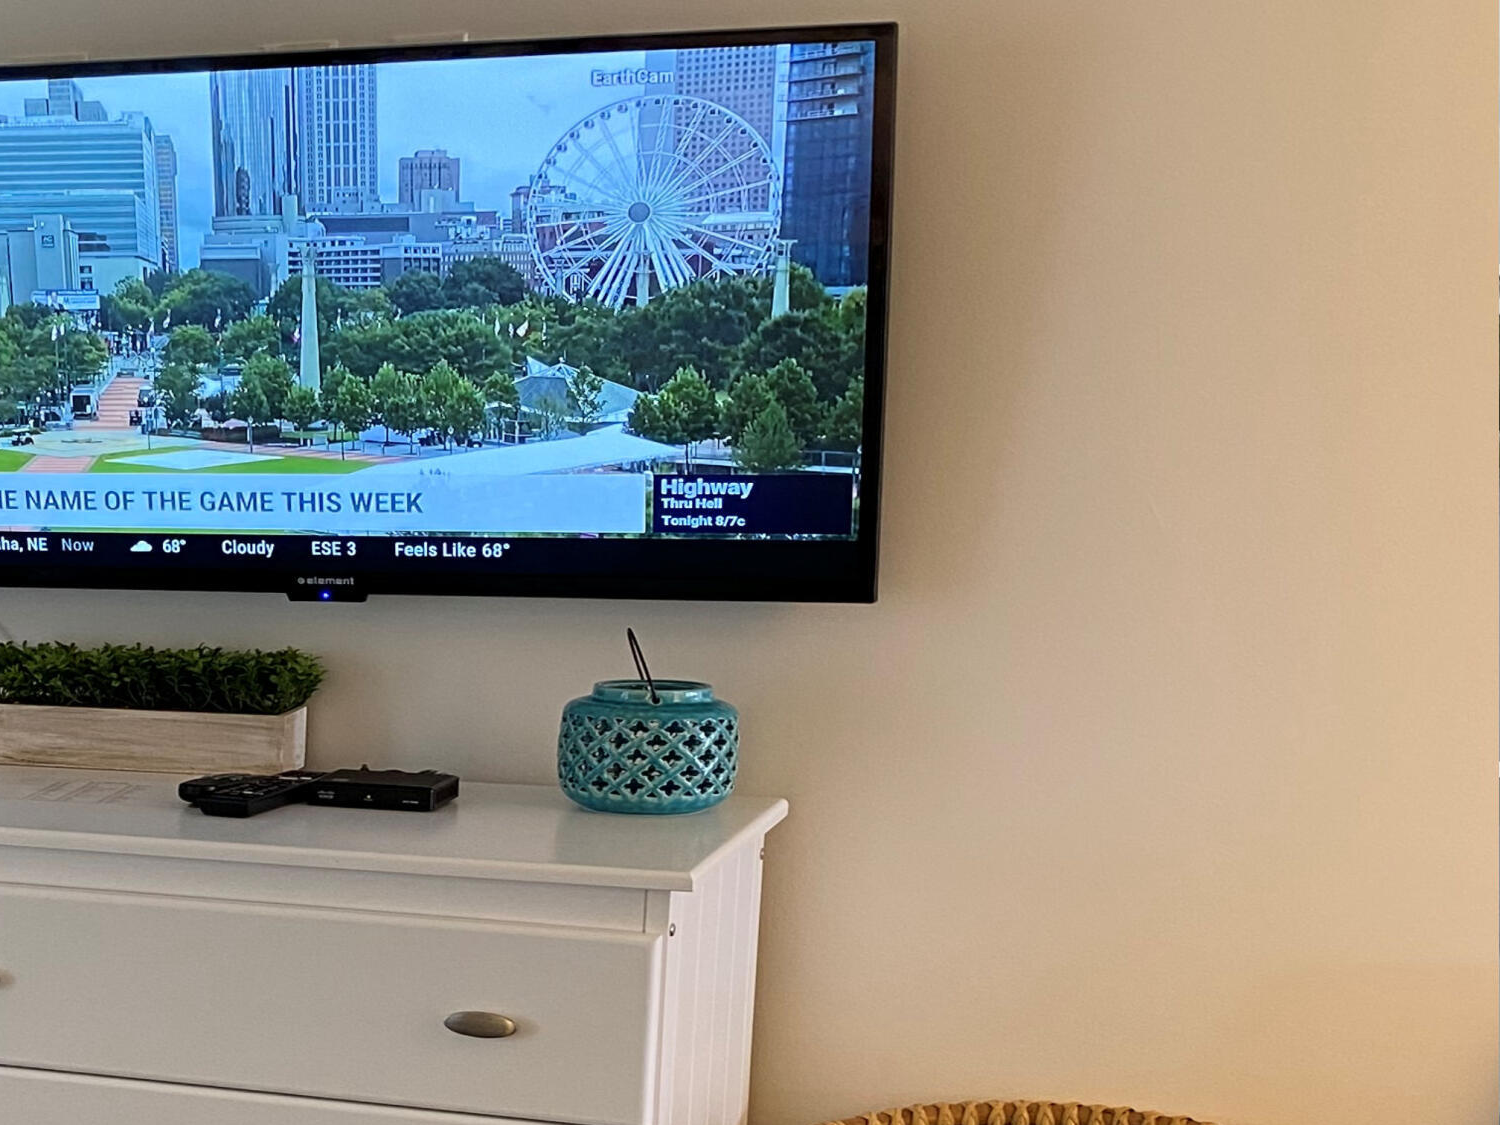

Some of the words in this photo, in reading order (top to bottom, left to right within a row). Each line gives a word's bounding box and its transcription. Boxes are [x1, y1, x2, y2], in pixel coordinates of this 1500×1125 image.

[591, 68, 674, 86] EarthCam
[661, 478, 754, 499] Highway
[25, 490, 97, 511] NAME
[104, 490, 135, 511] OF
[142, 491, 192, 511] THE
[200, 491, 274, 513] GAME
[281, 492, 342, 513] THIS
[350, 492, 424, 514] WEEK
[661, 497, 693, 509] Thru
[695, 498, 723, 509] Hell
[661, 515, 713, 528] Tonight
[715, 516, 746, 527] 8/7c
[27, 538, 48, 552] NE
[61, 538, 94, 552] Now
[162, 539, 187, 554] 68°
[221, 539, 275, 558] Cloudy
[311, 541, 342, 556] ESE
[347, 541, 357, 556] 3
[394, 542, 438, 558] Feels
[442, 542, 476, 558] Like
[482, 543, 510, 558] 68°
